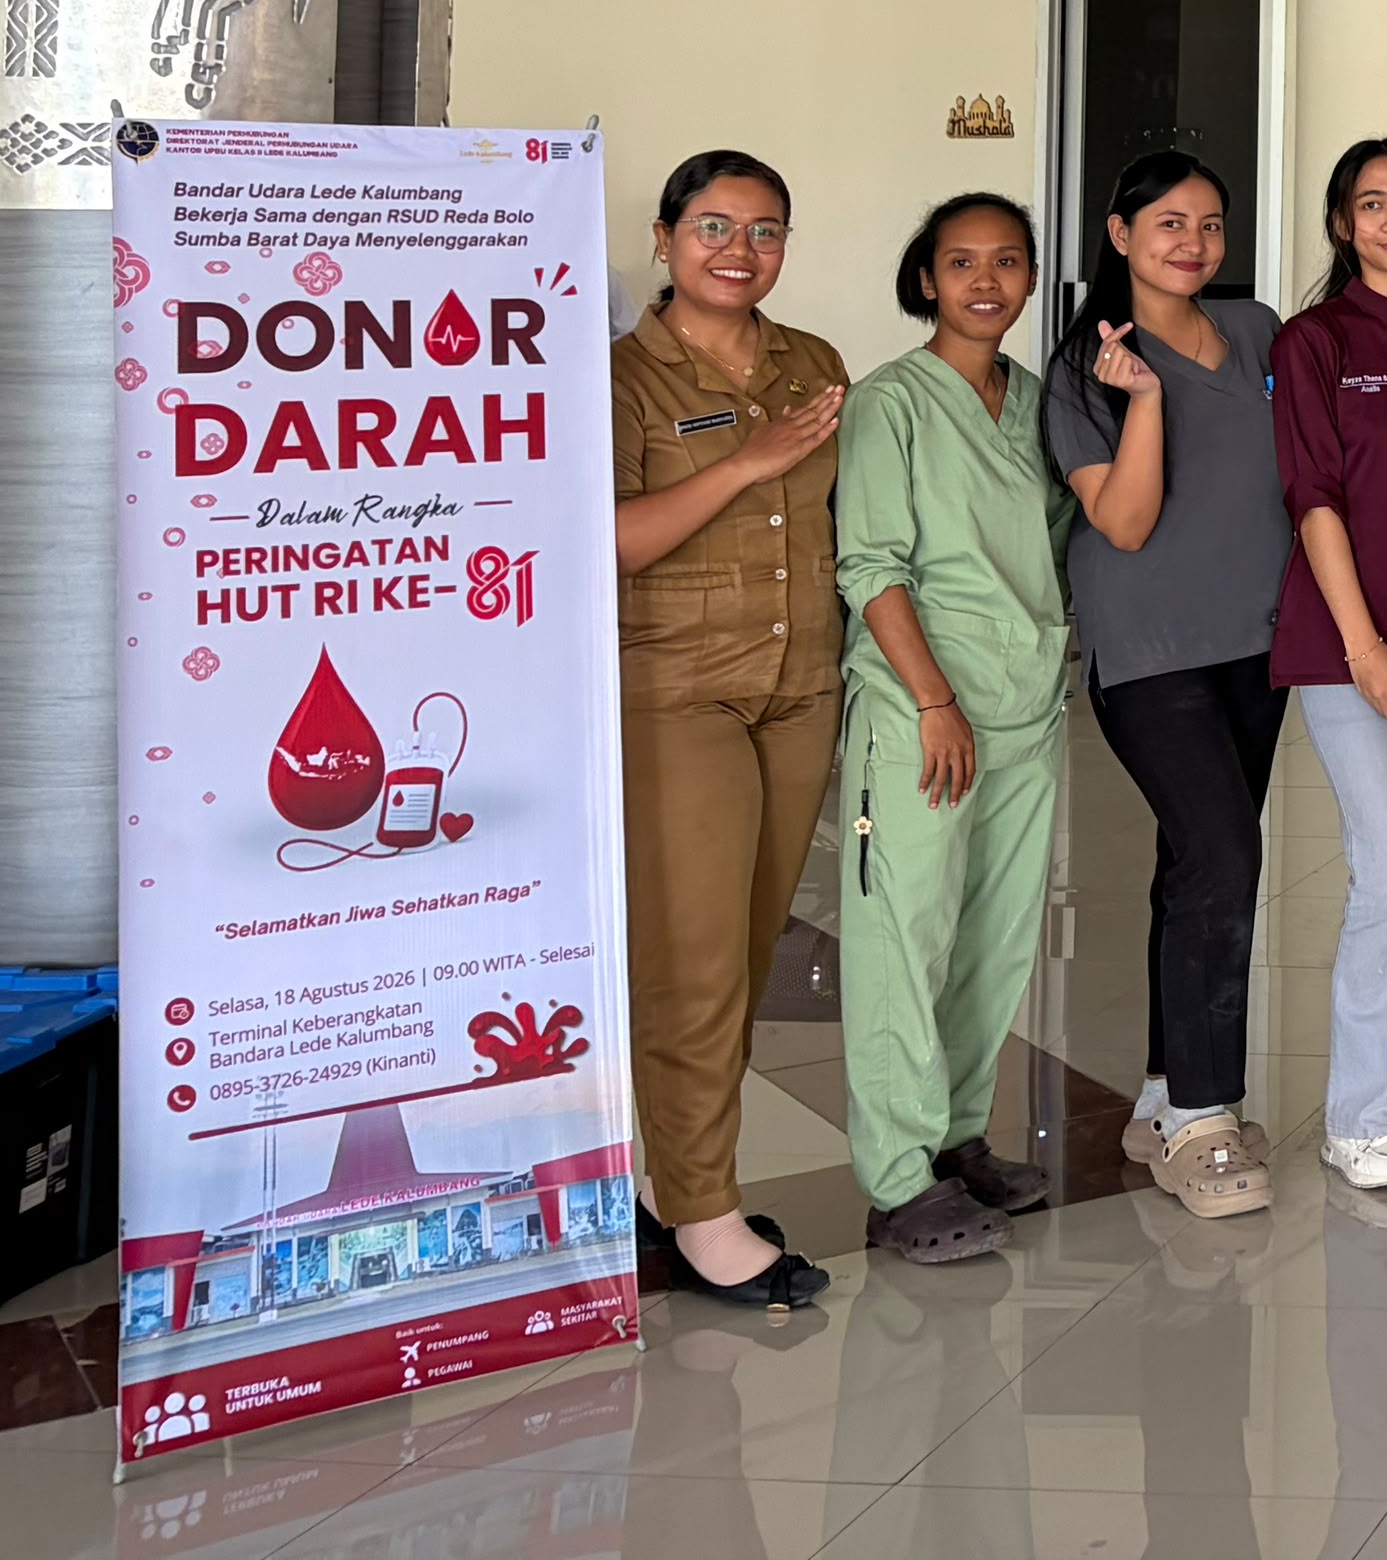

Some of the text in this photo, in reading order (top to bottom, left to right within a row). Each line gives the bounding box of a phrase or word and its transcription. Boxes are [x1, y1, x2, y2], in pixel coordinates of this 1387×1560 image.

[166, 129, 289, 139] KEMENTERIAN PERHUBUNGAN
[166, 137, 219, 146] DIREKTORAT
[222, 139, 265, 147] JENDERAL
[267, 140, 328, 149] PERHUBUNGAN
[228, 148, 255, 156] KELAS
[286, 150, 338, 158] KALUMBANG
[525, 138, 548, 164] 81
[173, 182, 463, 203] Bandar Udara Lede Kalumbang
[173, 207, 534, 226] Bekerja Sama dengan RSUD Reda Bolo
[173, 231, 528, 251] Sumba Barat Daya Menyelenggarakan
[176, 289, 547, 375] DONOR
[174, 392, 547, 477] DARAH
[256, 493, 464, 529] Dalam Rangka
[196, 534, 450, 578] PERINGATAN
[196, 583, 300, 626] HUT
[314, 579, 358, 617] RI
[345, 902, 386, 925] Jiwa
[391, 890, 479, 917] Sehatkan
[208, 993, 269, 1017] Selasa,
[274, 987, 296, 1006] 18
[299, 978, 369, 1005] Agustus
[373, 970, 416, 992] 2026
[433, 960, 480, 982] 09.00
[482, 953, 527, 974] WITA
[539, 942, 595, 965] Selesai
[208, 999, 423, 1047] Terminal Keberangkatan
[209, 1018, 434, 1070] Bandara Lede Kalumbang
[210, 1047, 437, 1101] 0895-3726-24929 (Kinanti)
[341, 1196, 381, 1212] LEDE
[385, 1176, 481, 1202] KALUMBANG
[561, 1296, 623, 1316] MASYARAKAT
[561, 1311, 597, 1327] SEKITAR
[426, 1330, 489, 1352] PENUMPANG
[428, 1360, 473, 1378] PEGAWAI
[225, 1376, 290, 1400] TERBUKA
[225, 1380, 322, 1414] UNTUK UMUM
